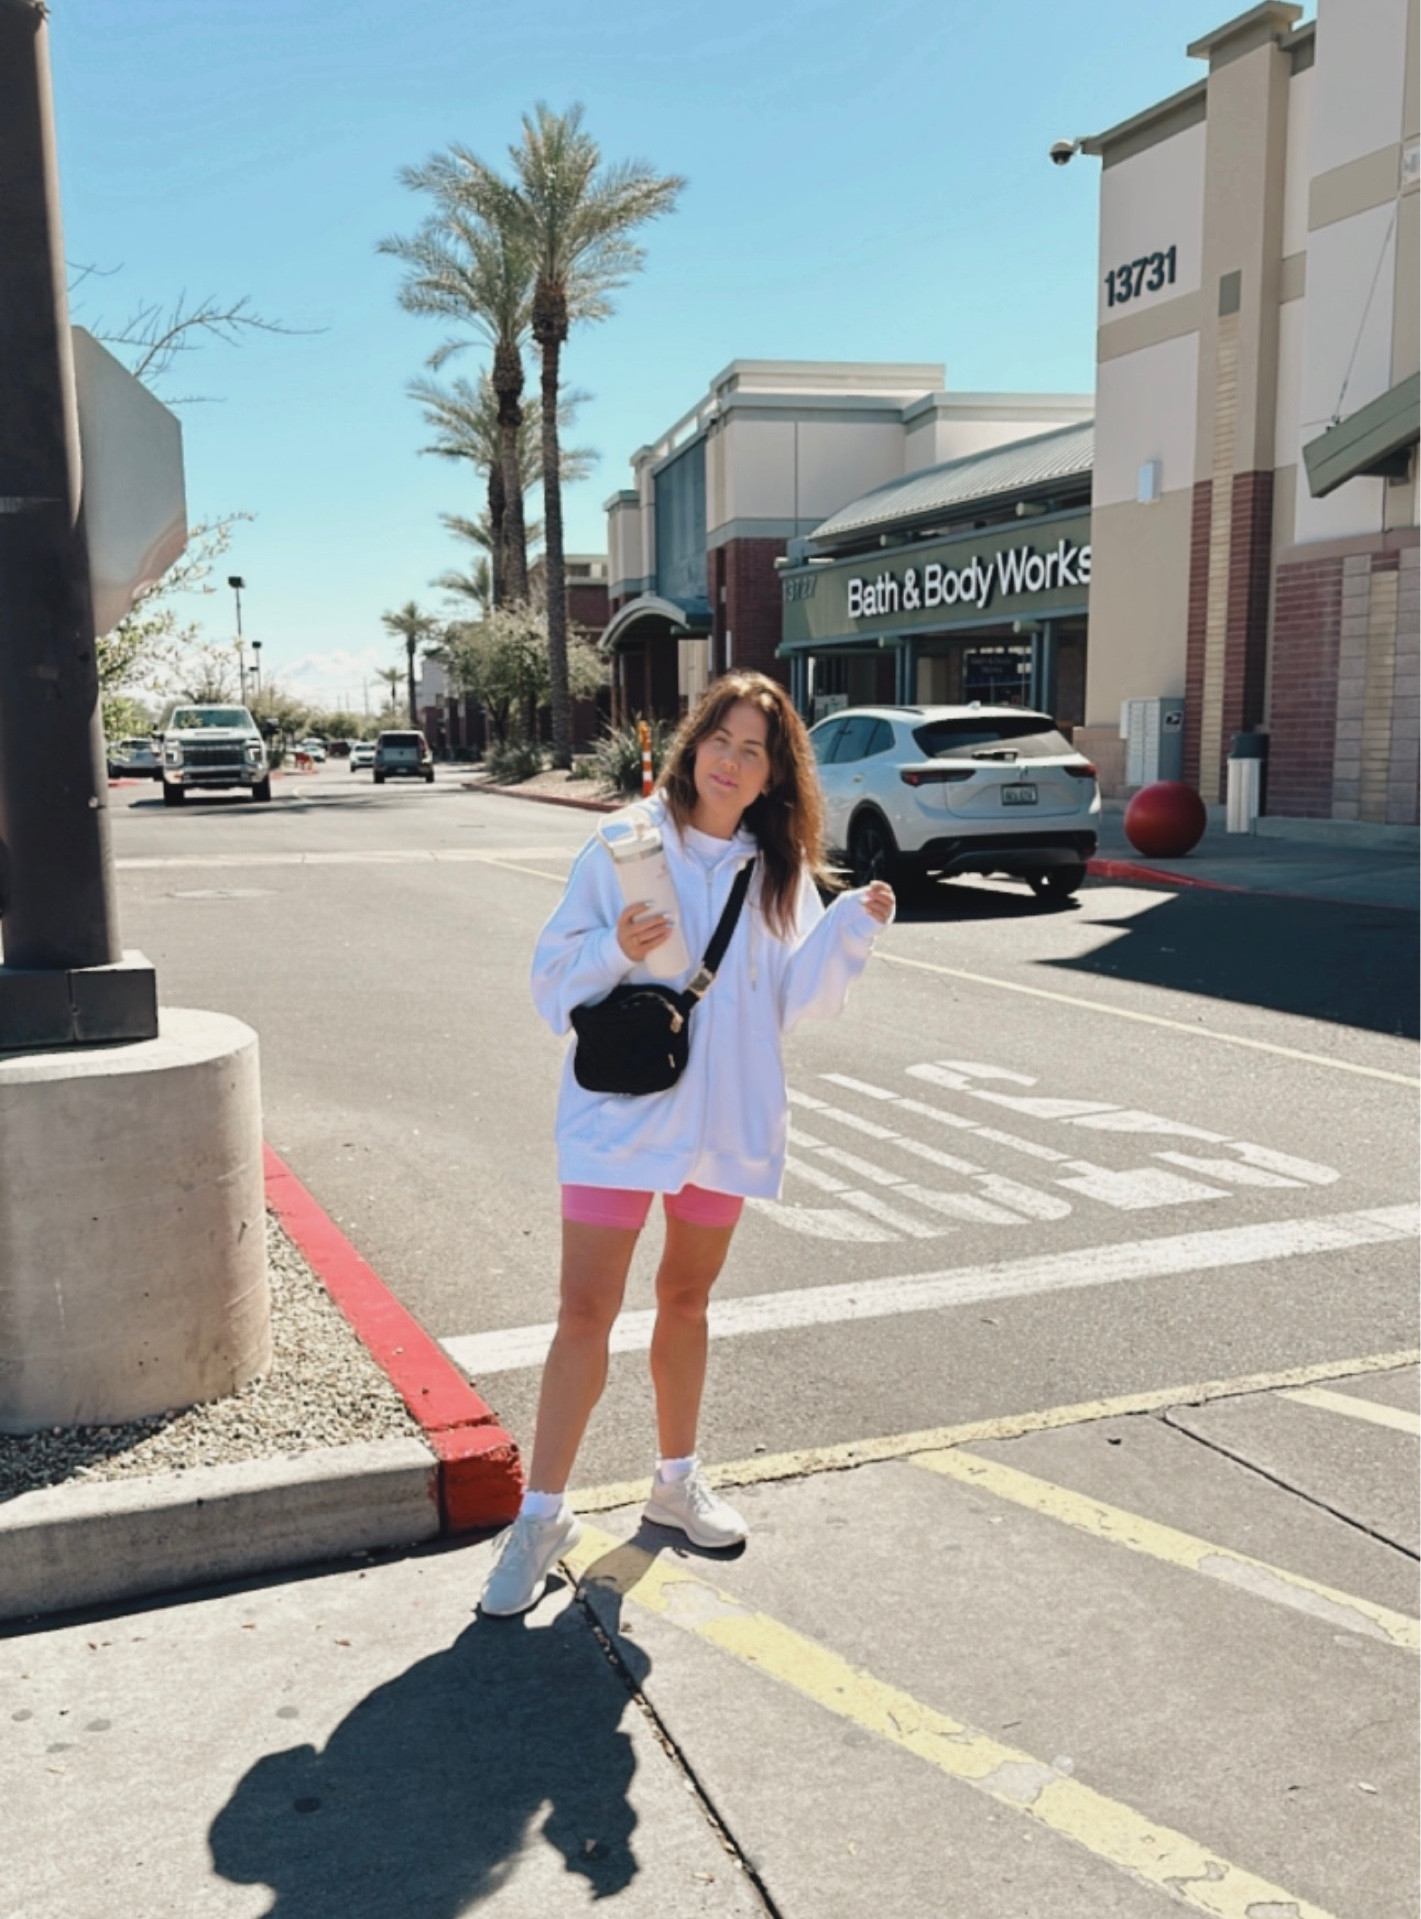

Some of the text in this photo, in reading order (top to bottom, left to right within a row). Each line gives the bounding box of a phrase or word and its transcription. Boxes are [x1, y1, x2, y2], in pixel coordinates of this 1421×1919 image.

[1104, 245, 1176, 307] 13731
[848, 539, 1091, 618] Bath & Body Works
